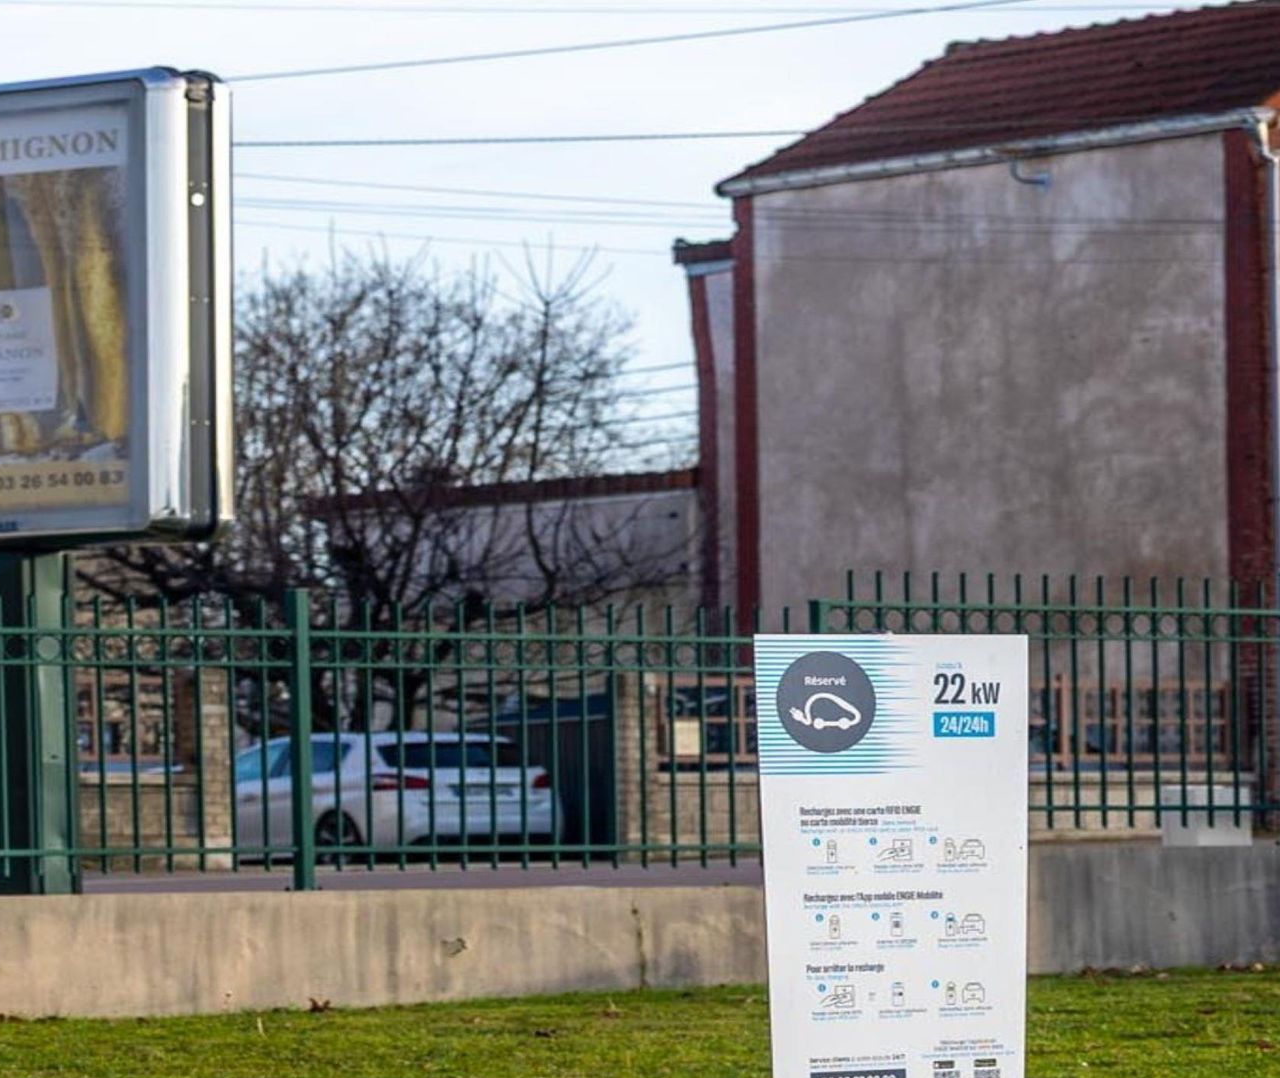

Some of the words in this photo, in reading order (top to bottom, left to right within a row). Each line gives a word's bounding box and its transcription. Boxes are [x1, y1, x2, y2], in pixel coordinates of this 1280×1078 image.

[20, 474, 42, 490] 26
[47, 472, 68, 488] 54
[73, 471, 95, 486] 00
[804, 675, 847, 686] Réservé
[933, 673, 966, 705] 22
[971, 682, 1001, 705] kW
[940, 716, 989, 736] 24/24h
[855, 962, 885, 973] recharge
